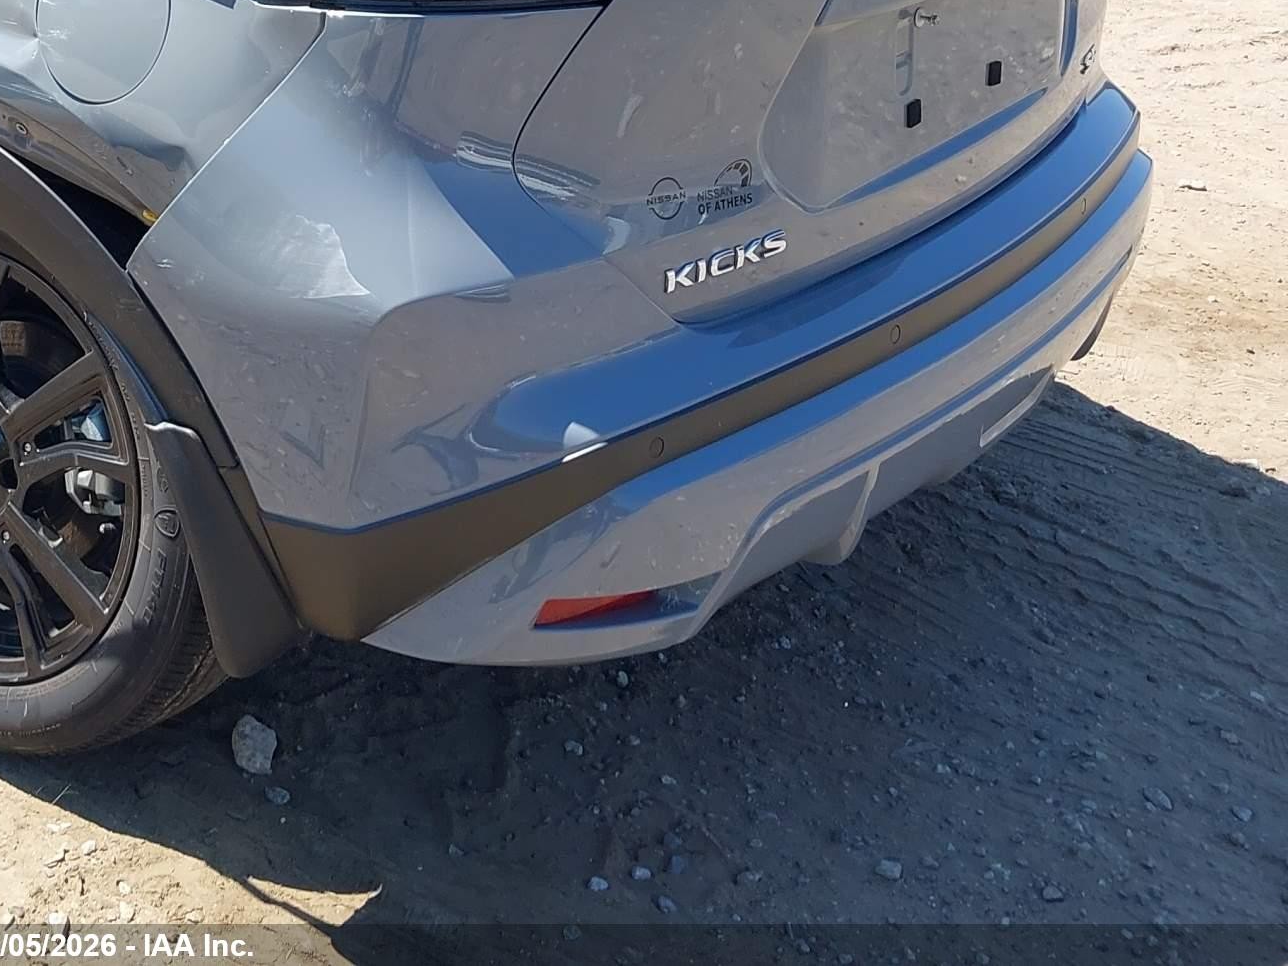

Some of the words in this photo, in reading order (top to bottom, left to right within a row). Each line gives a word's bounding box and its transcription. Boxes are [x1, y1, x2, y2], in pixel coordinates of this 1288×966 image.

[646, 190, 687, 206] NISSAN
[697, 185, 734, 202] NISSAN
[698, 202, 713, 216] OF
[713, 193, 753, 212] ATHENS
[664, 228, 788, 294] KICKS
